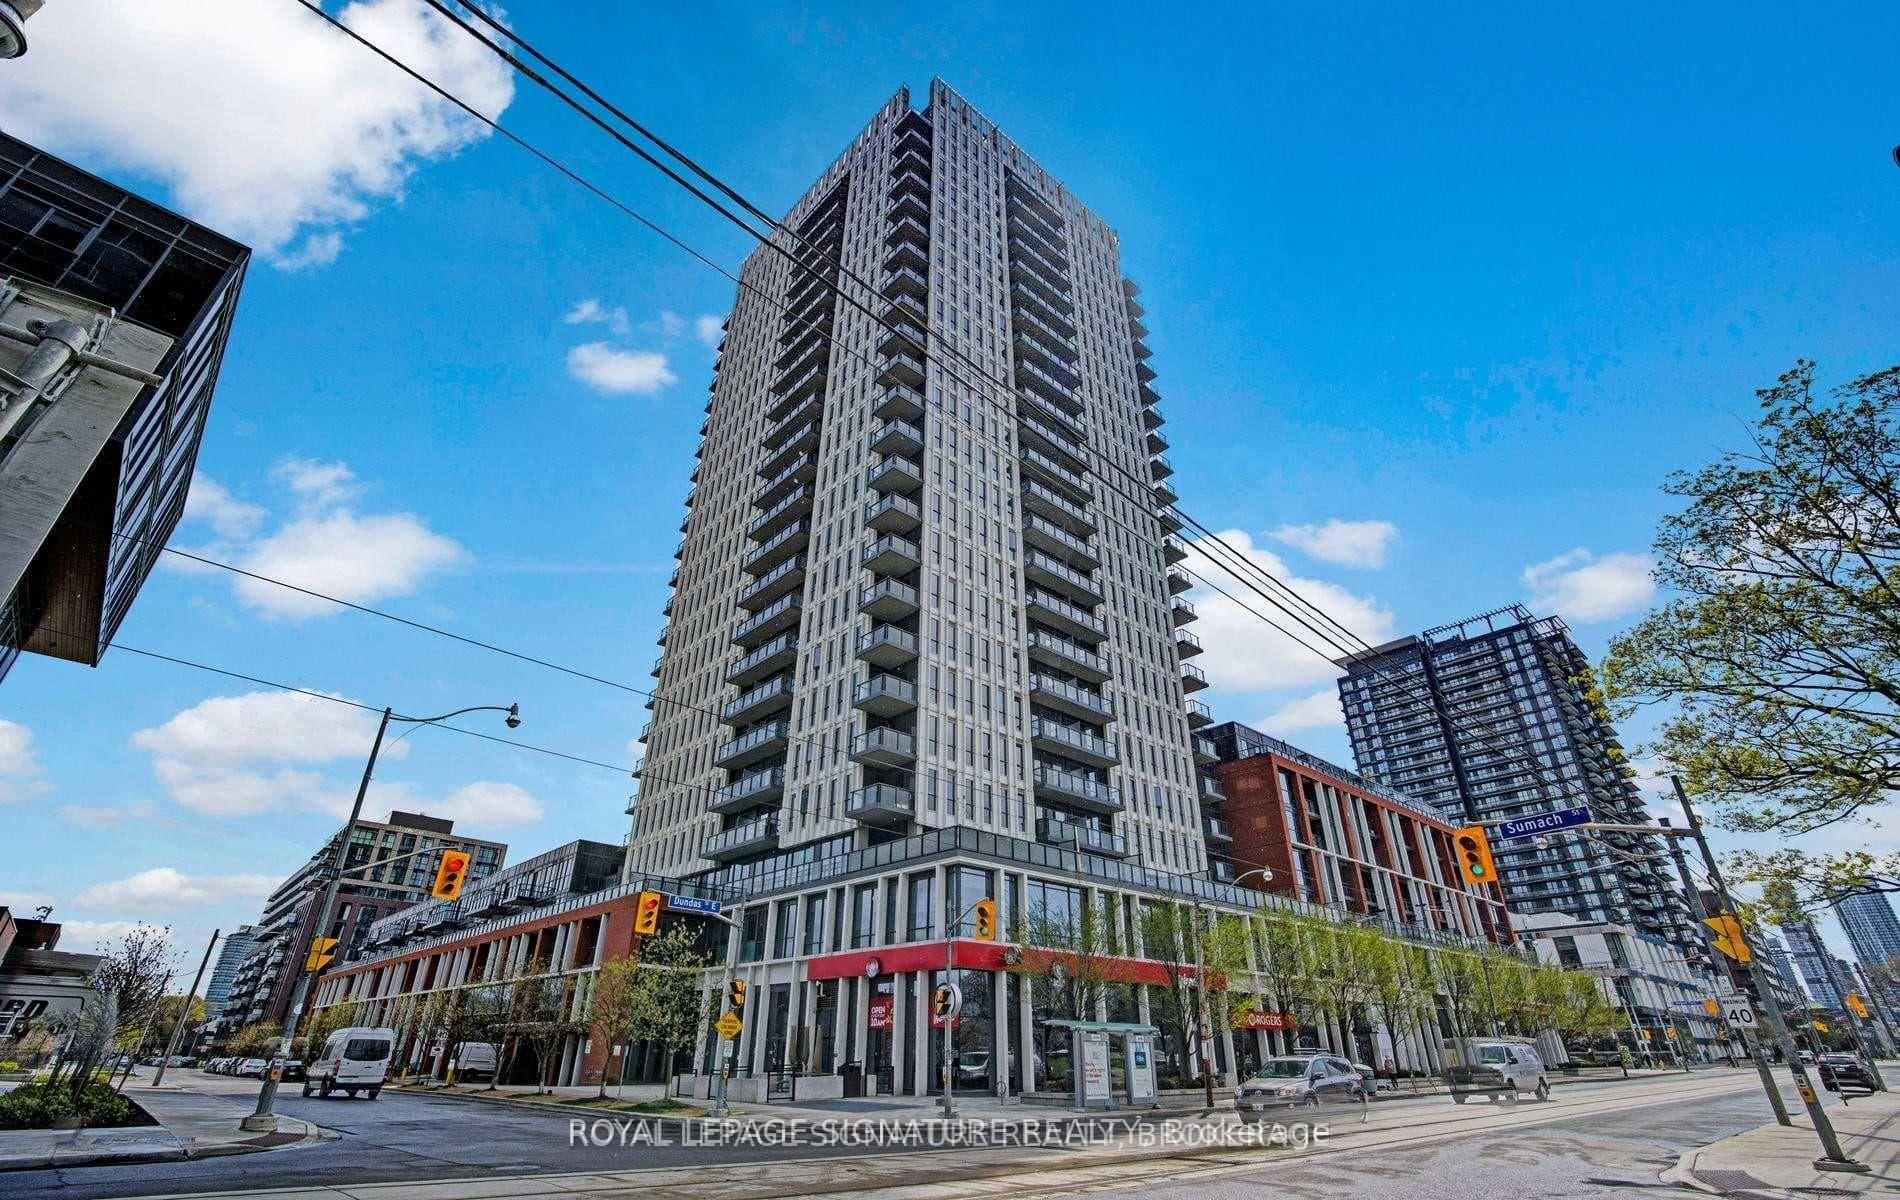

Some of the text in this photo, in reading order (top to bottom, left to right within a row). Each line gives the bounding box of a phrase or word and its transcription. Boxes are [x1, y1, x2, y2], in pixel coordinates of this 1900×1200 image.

[1506, 814, 1562, 834] Sumach
[673, 896, 702, 908] Dundas
[711, 902, 717, 911] E
[870, 1006, 886, 1015] OPEN
[1728, 1008, 1754, 1024] 40
[1255, 1014, 1282, 1026] ROGERS
